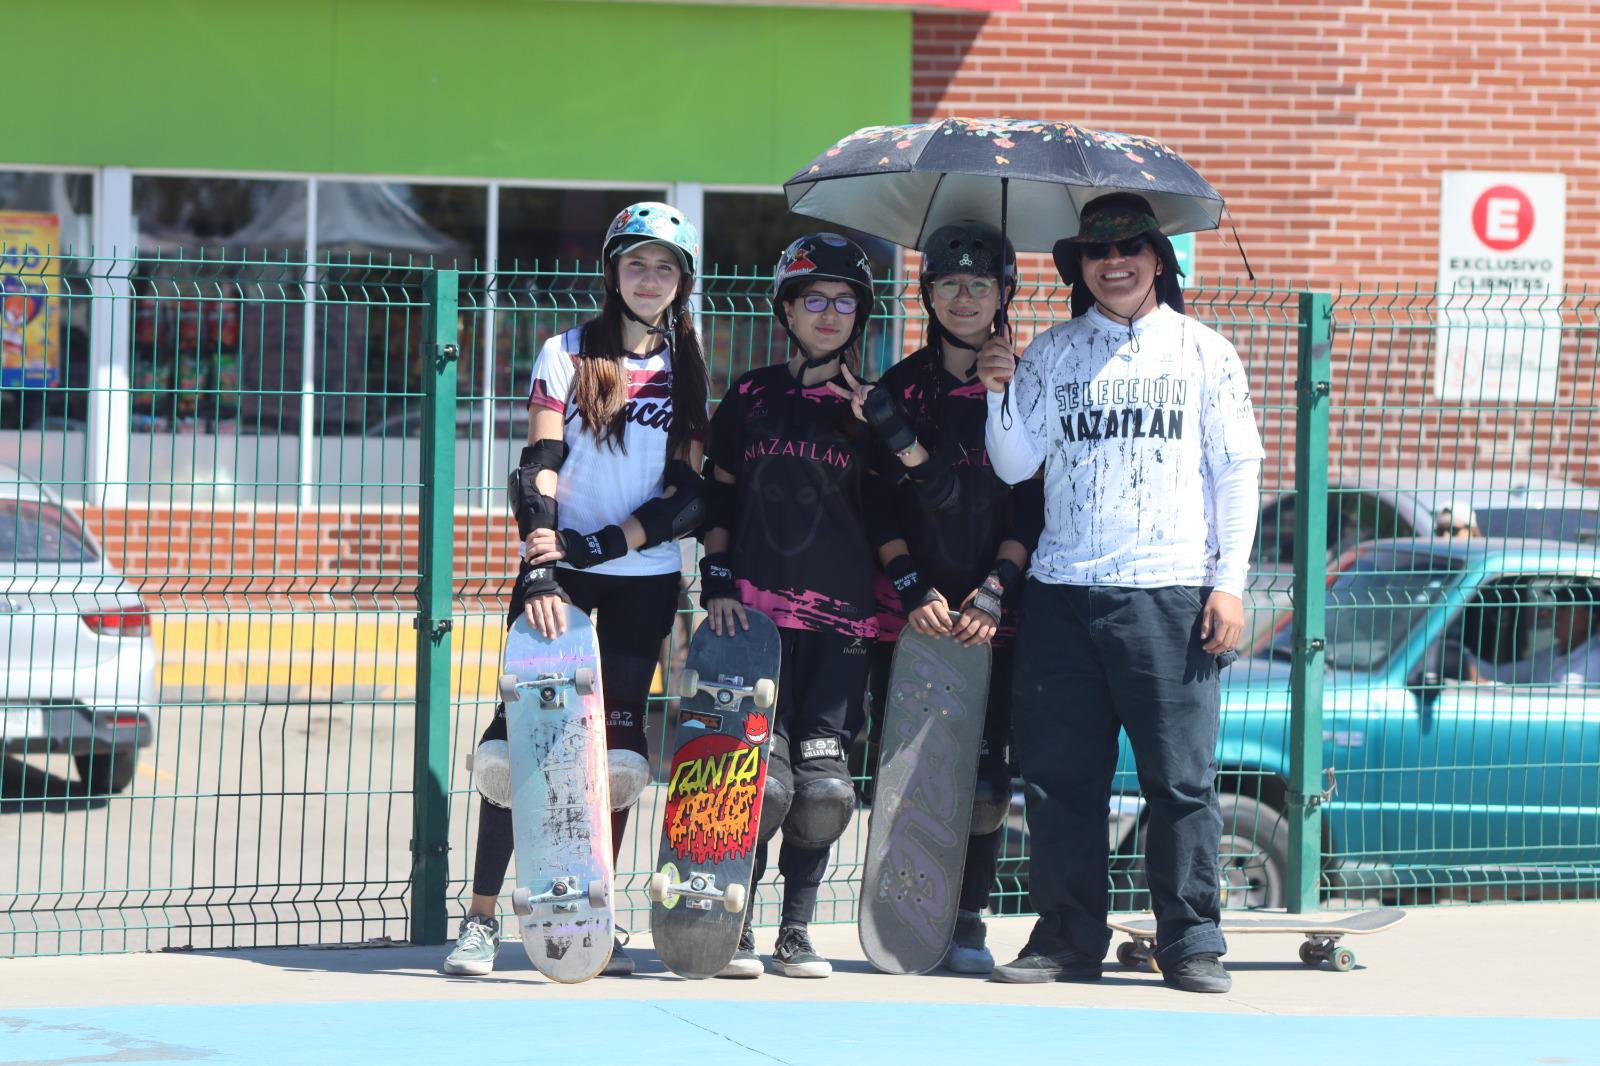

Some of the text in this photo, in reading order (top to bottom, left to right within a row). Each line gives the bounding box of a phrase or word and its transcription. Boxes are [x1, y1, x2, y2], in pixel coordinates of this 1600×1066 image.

[1485, 197, 1521, 241] E
[1449, 256, 1552, 271] EXCLUSIVO
[1457, 275, 1543, 289] CLIENTES
[1054, 374, 1187, 412] SELECCIÓN
[805, 740, 836, 751] 187
